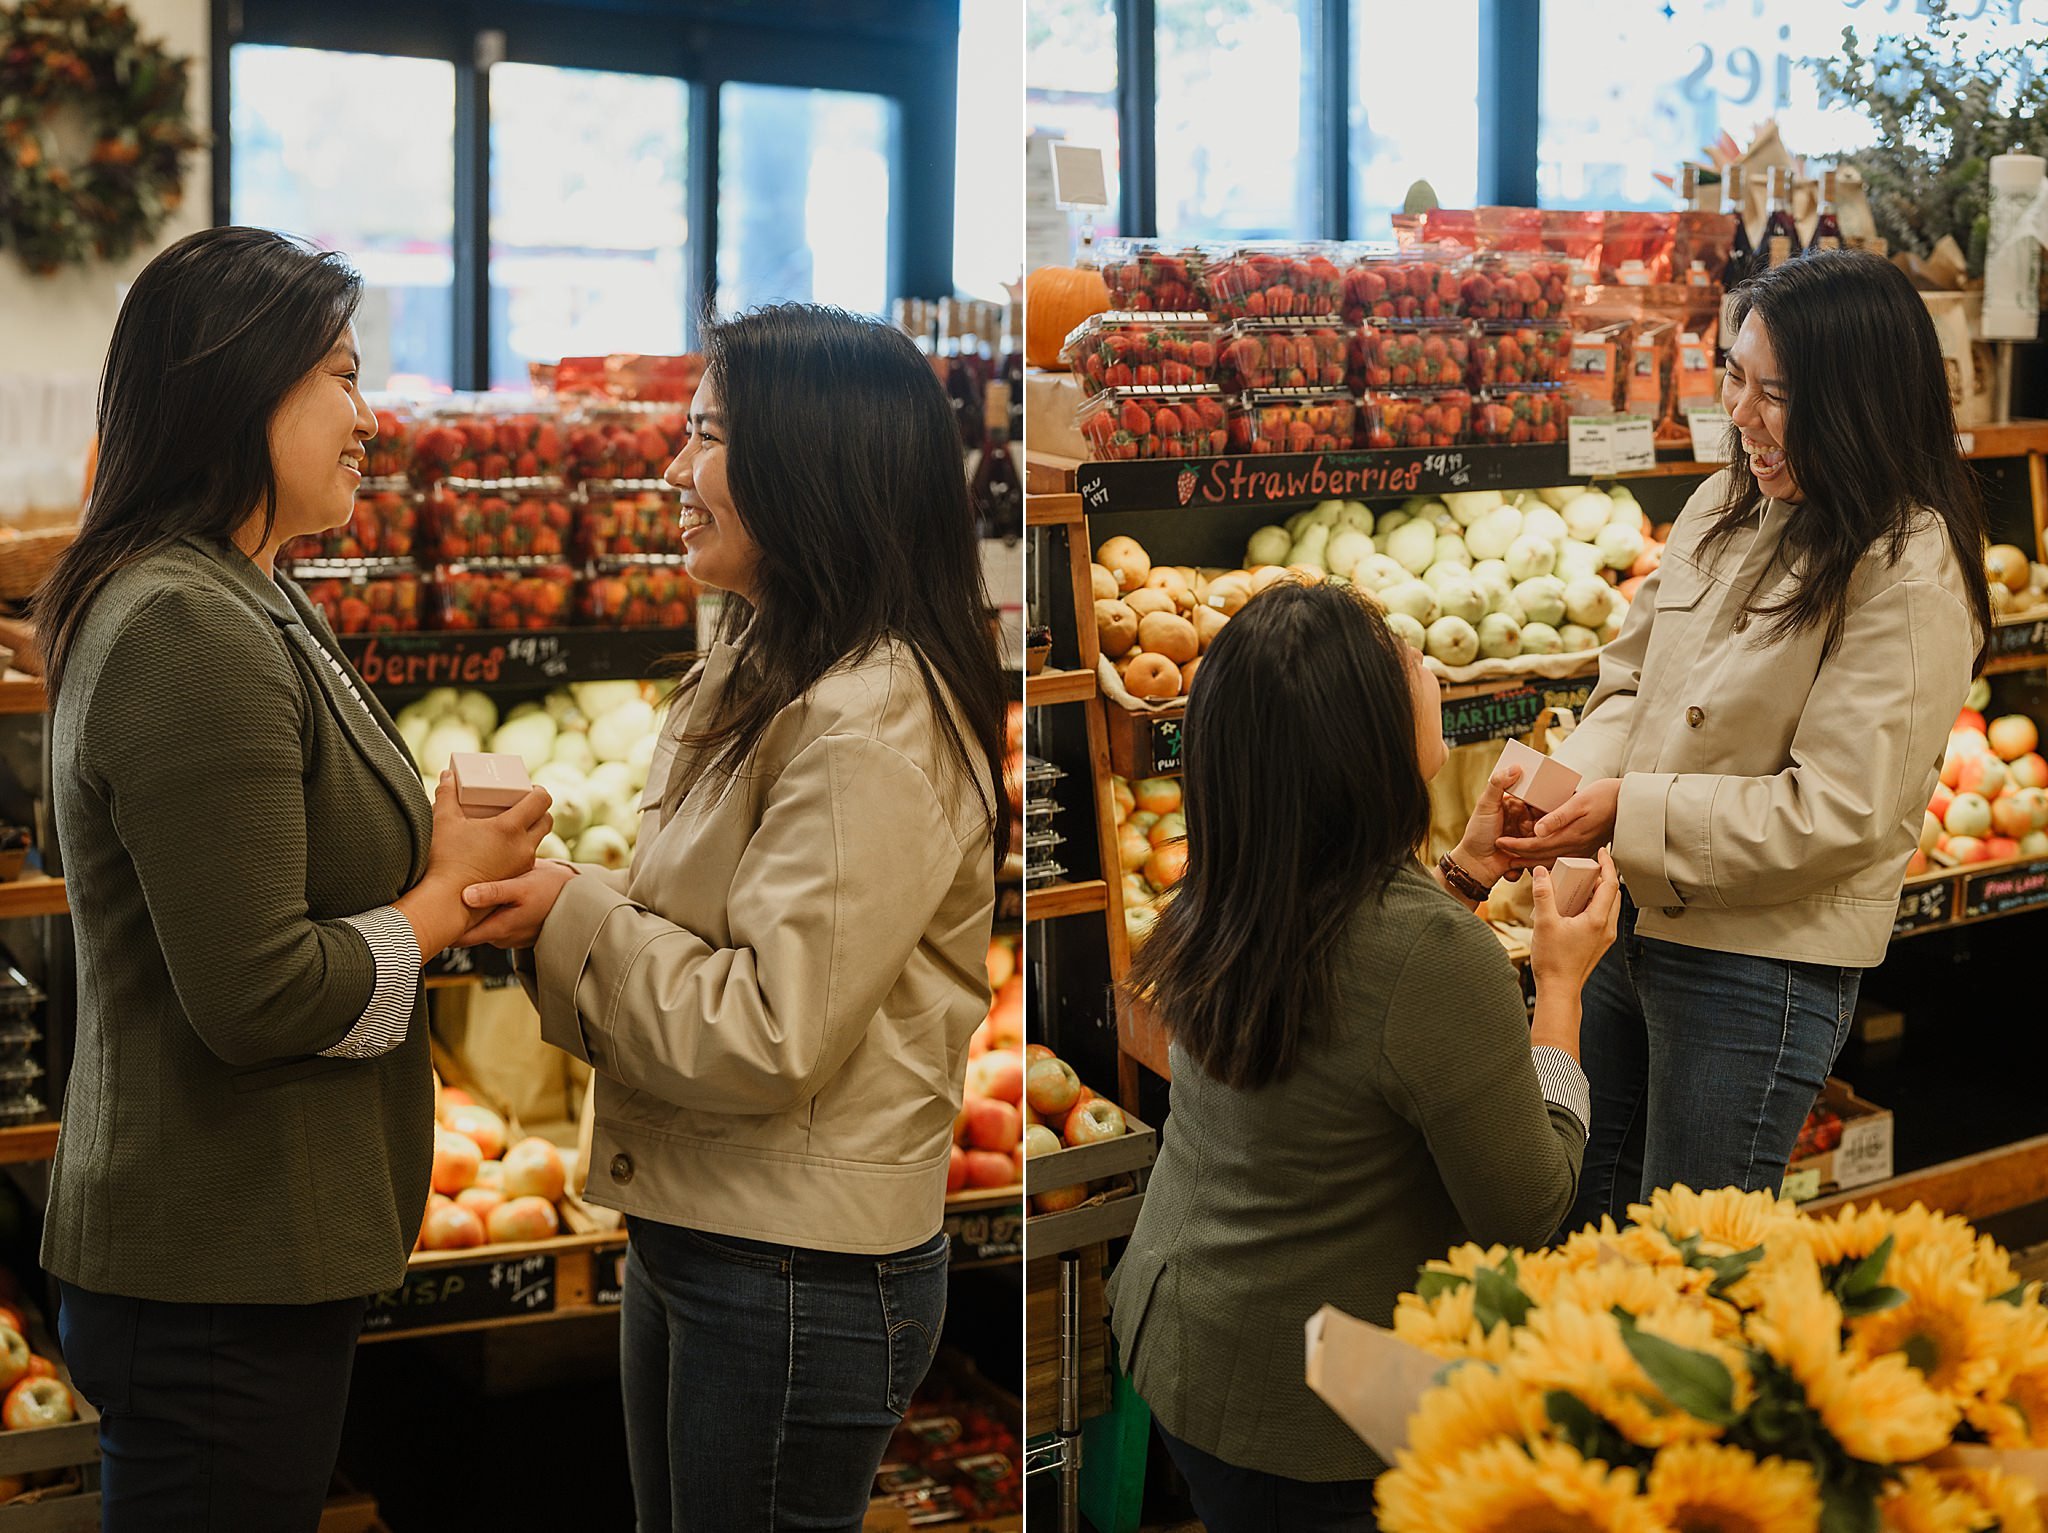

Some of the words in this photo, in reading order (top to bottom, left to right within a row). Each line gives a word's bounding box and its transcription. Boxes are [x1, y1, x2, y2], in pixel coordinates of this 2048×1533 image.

[1082, 477, 1100, 498] PLU
[1203, 456, 1422, 502] Strawberries
[1090, 487, 1109, 507] 197
[360, 639, 506, 685] berries
[1443, 697, 1538, 731] BARTLETT
